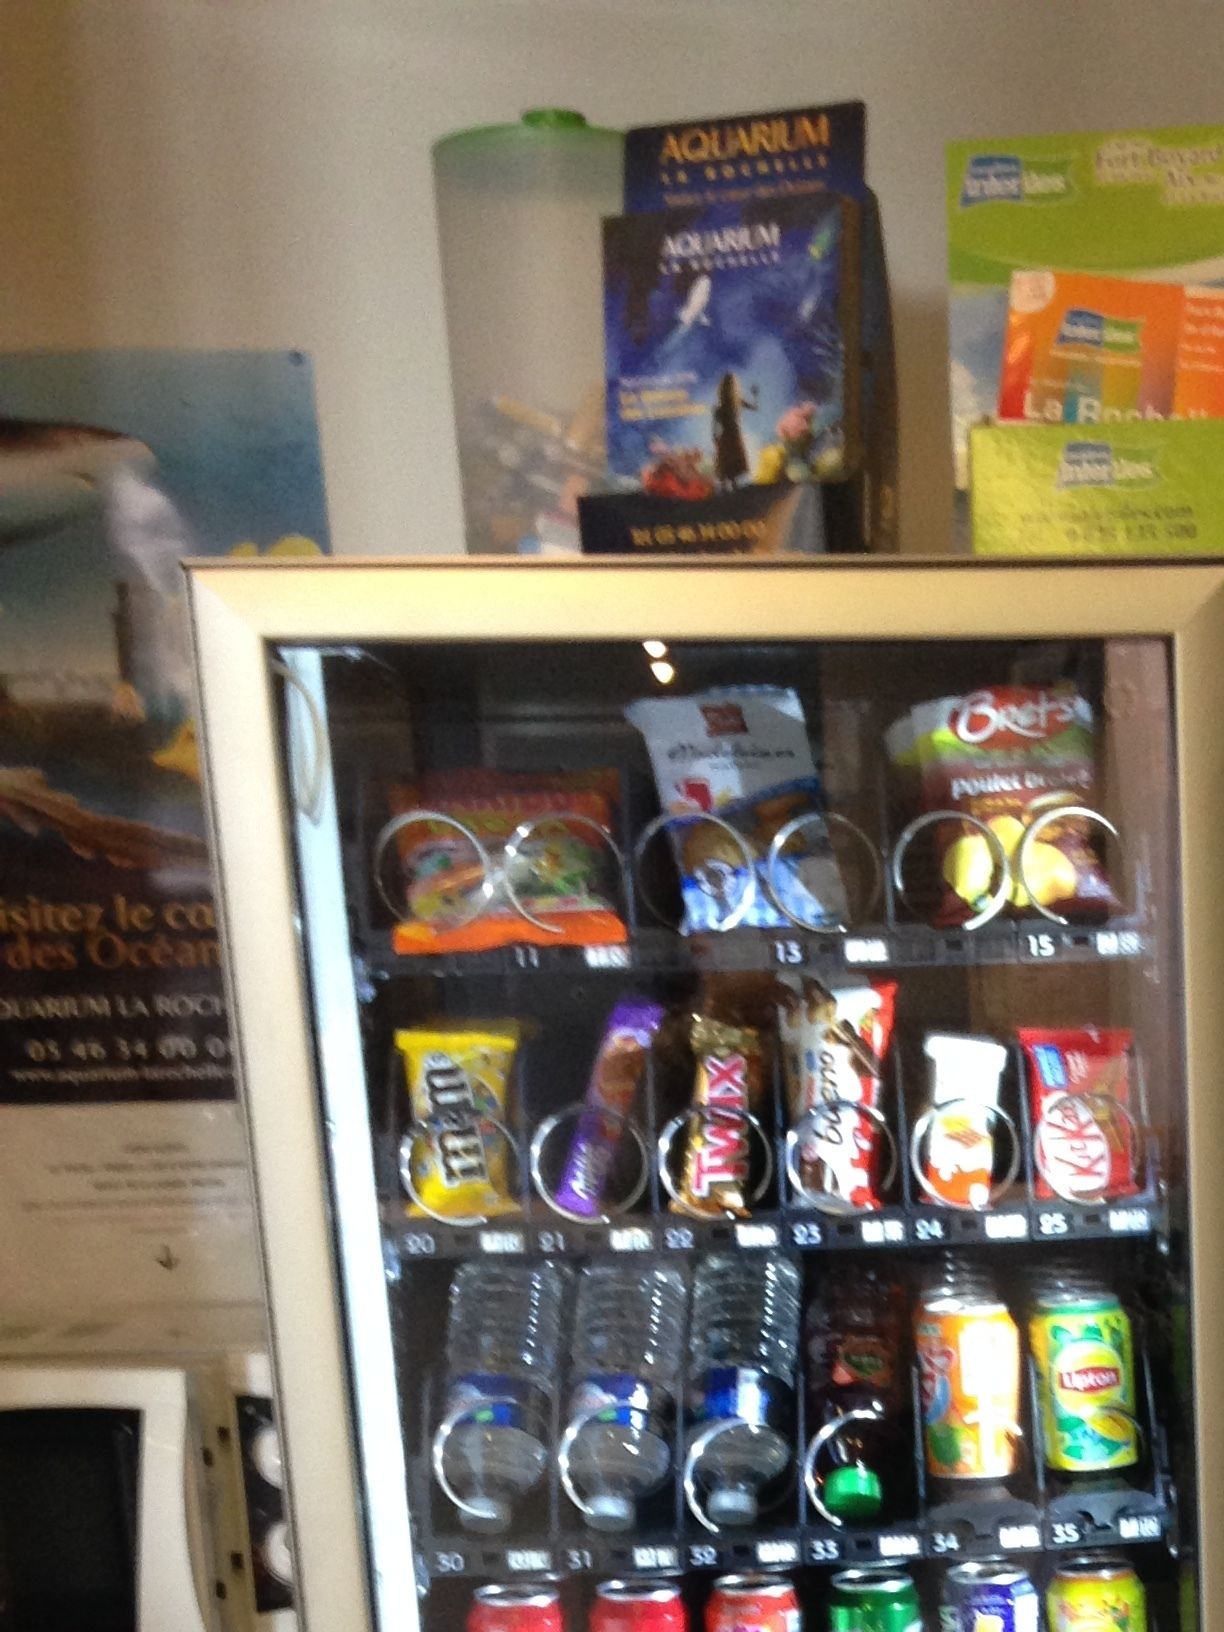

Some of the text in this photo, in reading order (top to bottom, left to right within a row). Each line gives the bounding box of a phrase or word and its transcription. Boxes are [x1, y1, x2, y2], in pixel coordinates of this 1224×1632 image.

[660, 114, 830, 164] AQUARIUM
[660, 222, 780, 258] AQUARIUM
[0, 895, 104, 932] isitez
[6, 932, 78, 970] des
[692, 1054, 749, 1198] TWIX
[1061, 1369, 1119, 1392] Lipton
